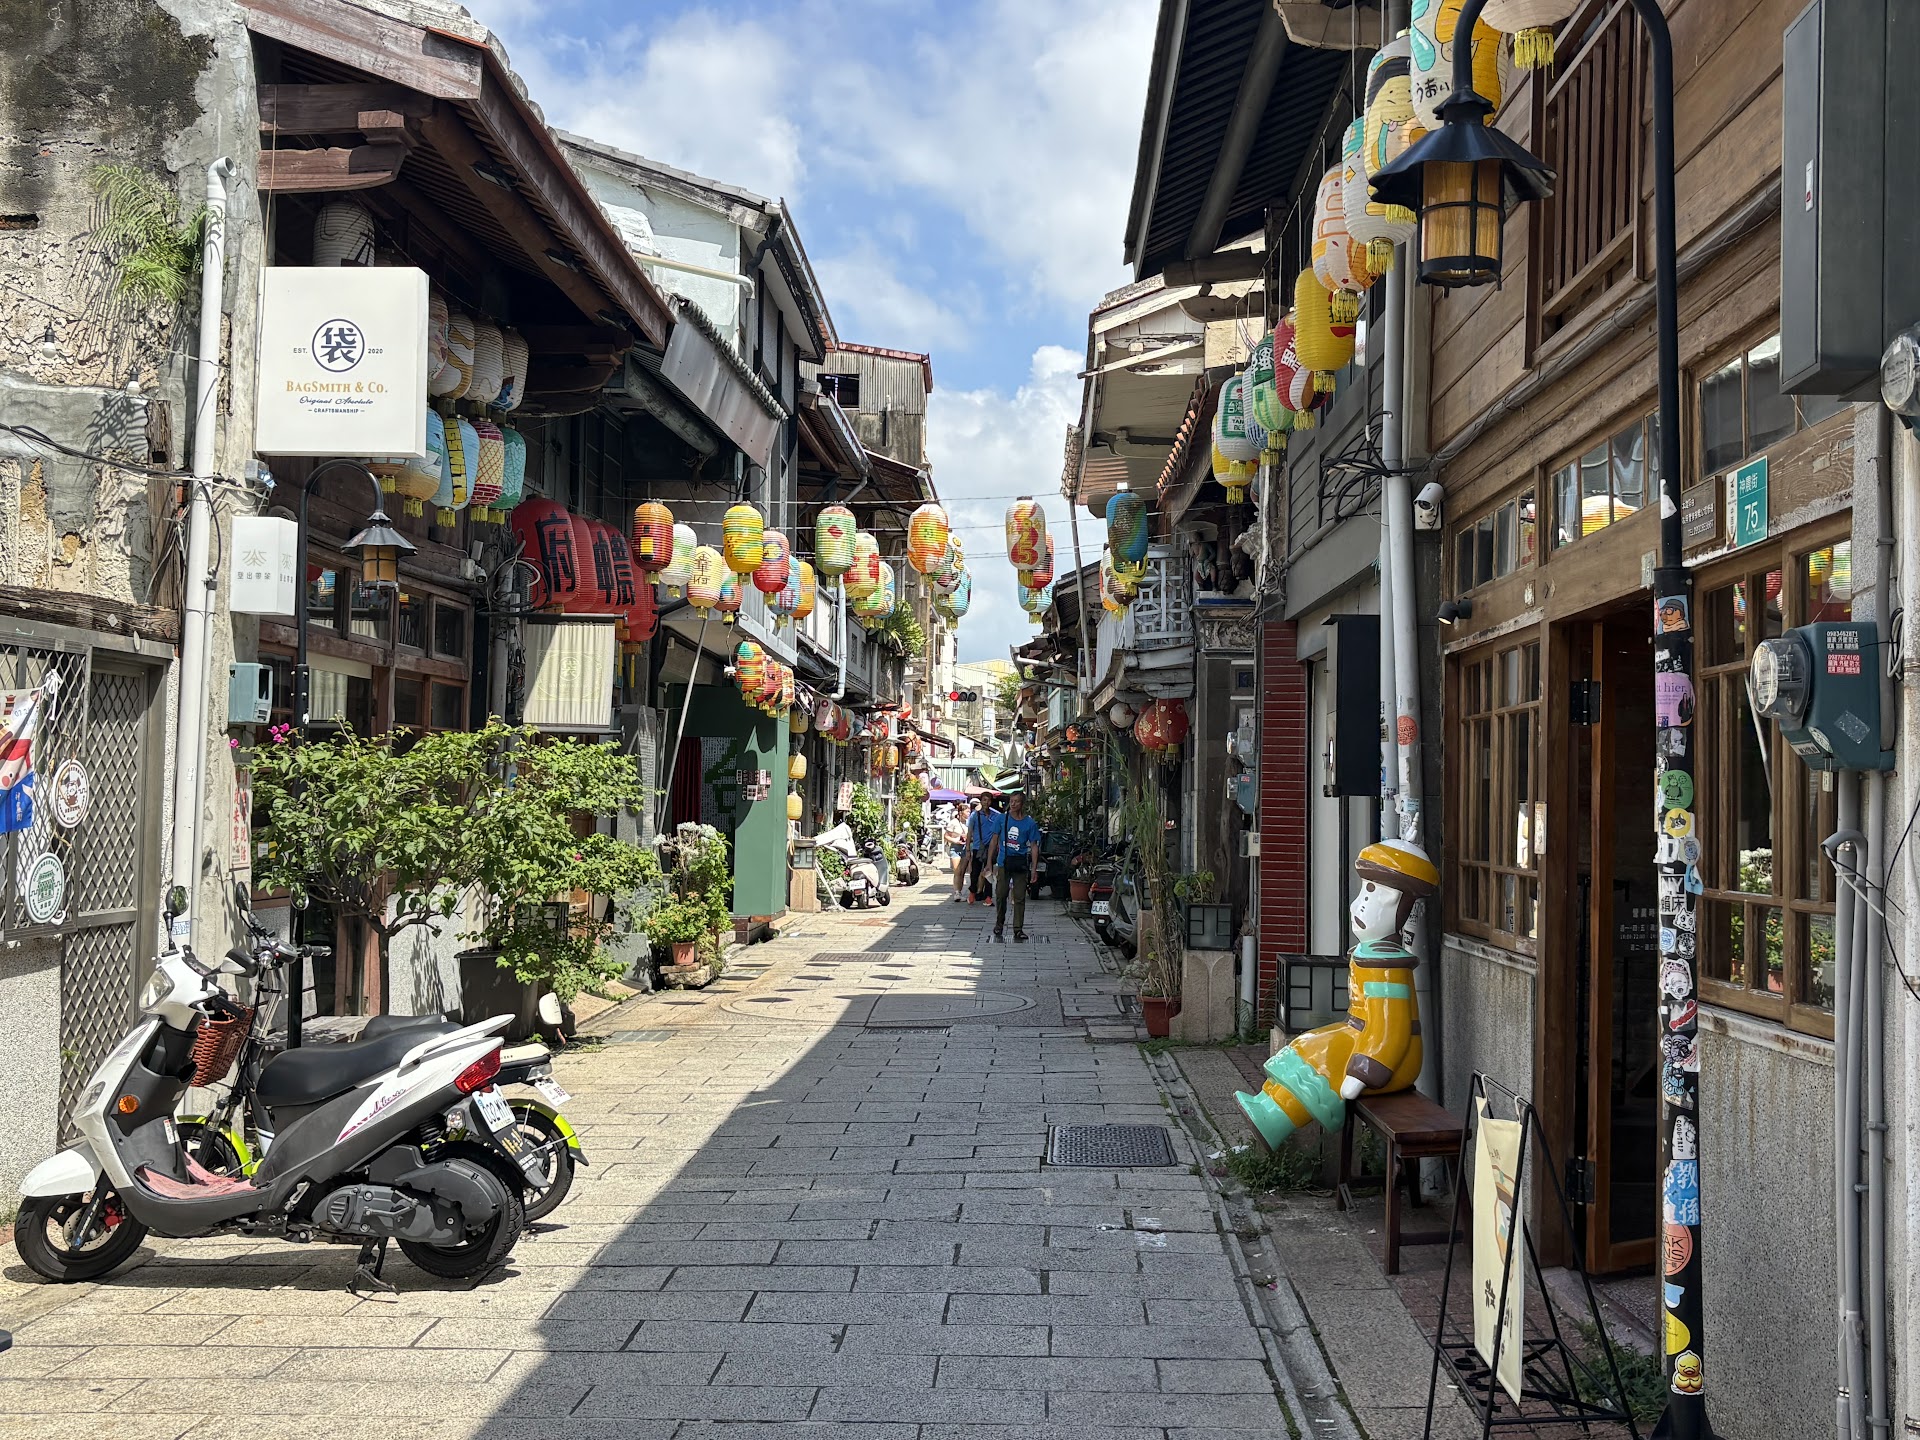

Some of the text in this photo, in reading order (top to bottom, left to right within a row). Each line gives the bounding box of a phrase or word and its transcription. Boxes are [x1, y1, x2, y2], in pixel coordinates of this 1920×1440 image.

[319, 327, 357, 364] 袋
[354, 382, 364, 393] &
[299, 395, 332, 405] Original
[1744, 501, 1758, 531] 75
[1664, 681, 1688, 693] hier.
